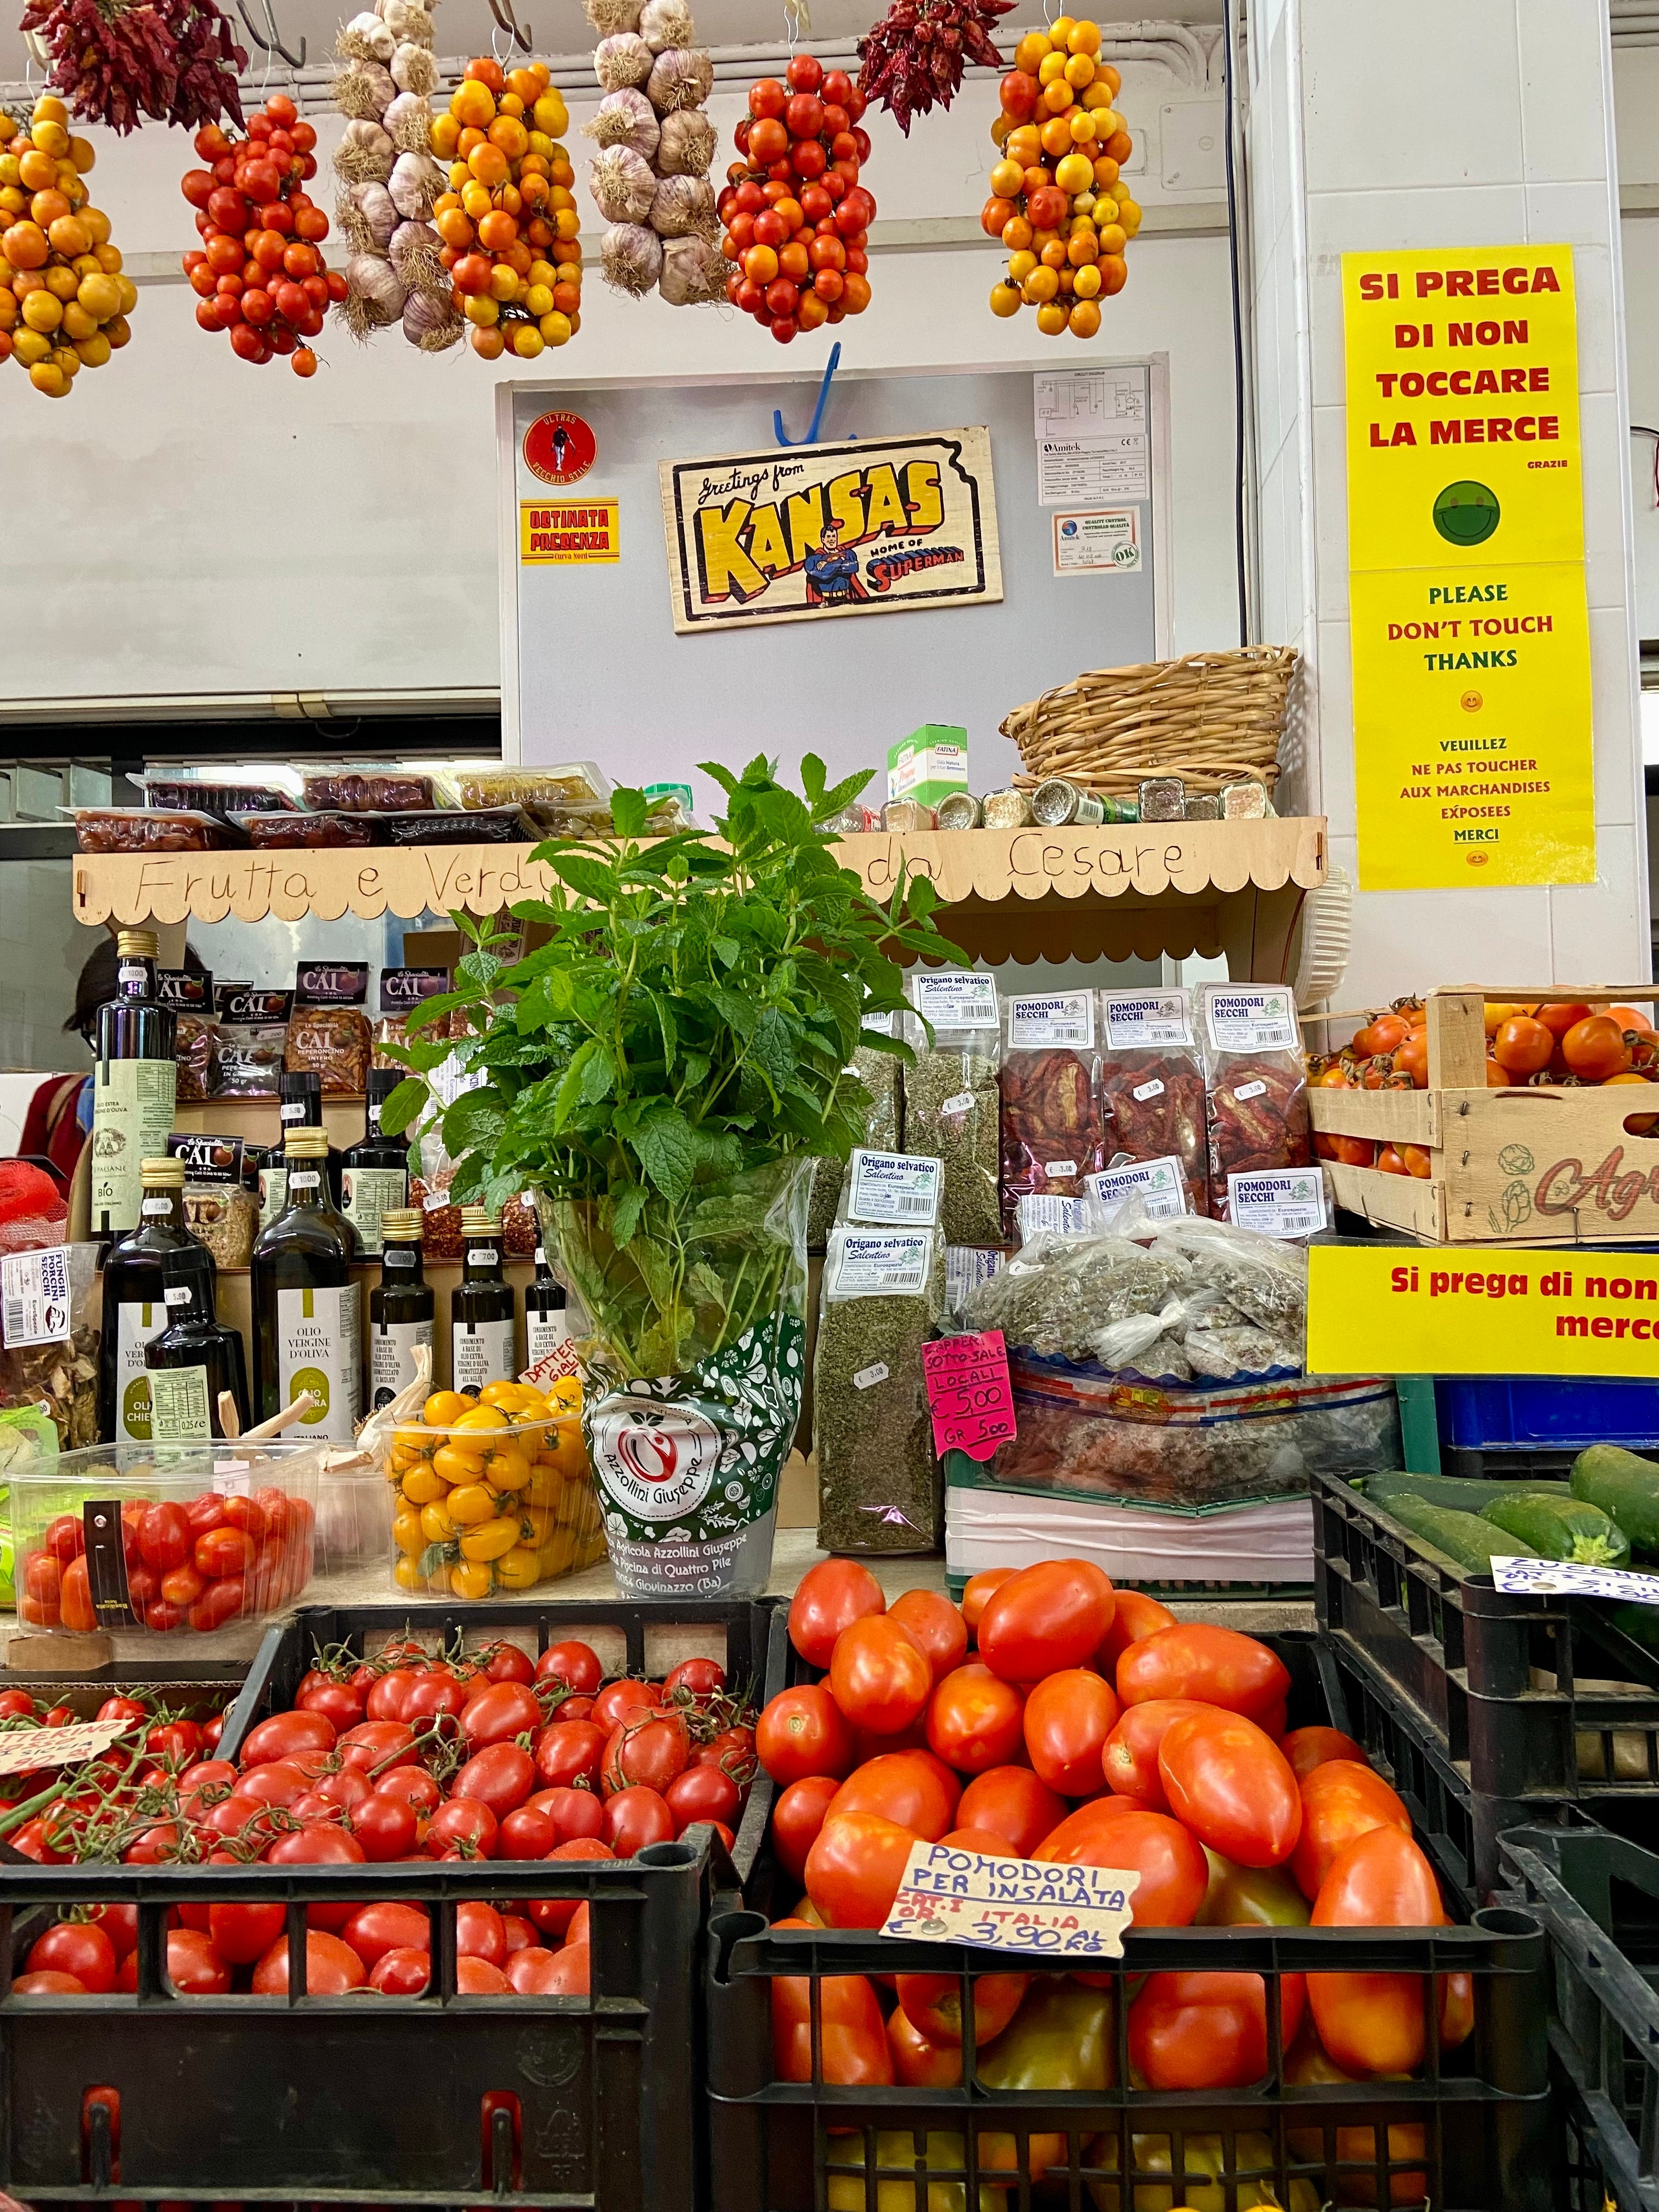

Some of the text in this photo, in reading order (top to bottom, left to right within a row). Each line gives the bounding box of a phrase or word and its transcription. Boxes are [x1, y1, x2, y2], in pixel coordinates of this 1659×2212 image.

[1359, 267, 1561, 300] SI PREGA
[1395, 320, 1528, 348] DI NON
[1376, 368, 1549, 398] TOCCARE
[543, 414, 577, 425] ULTRAS
[1370, 416, 1559, 447] LA MERCE
[1052, 443, 1081, 452] Amitek
[533, 460, 591, 483] VECCHIO STILE
[1527, 460, 1567, 469] GRAZIE
[698, 464, 804, 504] Greetings from
[531, 509, 609, 528] OSTINATA
[531, 532, 609, 551] PRESENZA
[693, 460, 945, 605] KANSAS
[871, 538, 923, 557] HOME OF
[1115, 547, 1135, 561] OK
[866, 546, 964, 592] SUPERMAN
[1429, 584, 1508, 604] PLEASE
[1388, 616, 1553, 640] DON'T TOUCH
[1424, 650, 1517, 671] THANKS
[1440, 738, 1507, 752] VEUILLEZ
[1412, 759, 1538, 775] NE PAS TOUCHER
[1400, 781, 1550, 798] AUX MARCHANDISES
[1454, 829, 1499, 842] MERCI
[135, 834, 1183, 910] Frutta e Verdu da Cesare
[1015, 1001, 1064, 1011] POMODORI
[1110, 1002, 1159, 1013] POMODORI
[1214, 998, 1264, 1008] POMODORI
[1110, 1012, 1143, 1022] SECCHI
[1215, 1009, 1249, 1018] SECCHI
[1147, 1083, 1159, 1092] 3.00
[1249, 1084, 1261, 1093] 3.00
[861, 1156, 934, 1172] Origano selvatico
[864, 1169, 904, 1180] Salentino
[1098, 1171, 1150, 1190] POMODORI
[1238, 1180, 1291, 1192] POMODORI
[1238, 1193, 1275, 1203] SECCHI
[846, 1238, 923, 1250] Origano selvatico
[848, 1250, 890, 1260] Salentino
[41, 1256, 51, 1297] SECCHI
[48, 1255, 59, 1302] PORCINI
[55, 1254, 66, 1297] FUNGHI
[1391, 1266, 1658, 1300] Si prega di non
[297, 1327, 321, 1336] OLIO
[288, 1338, 330, 1348] VERGINE
[290, 1348, 330, 1359] D'OLIVA
[524, 1338, 575, 1384] DATTER
[870, 1367, 883, 1378] 3.00
[934, 1368, 996, 1390] LOCALI
[930, 1398, 950, 1419] €
[944, 1419, 1008, 1444] GR 500
[604, 1453, 702, 1505] Azzollini Giuseppe
[617, 1539, 651, 1558] Agricola
[654, 1547, 699, 1559] Azzollini
[703, 1533, 747, 1556] Giuseppe
[621, 1556, 731, 1578] Piscina di Quattro Pile
[635, 1579, 694, 1593] Giovinazzo
[697, 1575, 721, 1593] (Ba)
[2, 1723, 122, 1743] TTERINO
[928, 1846, 1098, 1888] POMODORI
[914, 1868, 1125, 1908] PER INSALATA
[886, 1919, 916, 1934] €
[982, 1910, 1079, 1929] ITALIA
